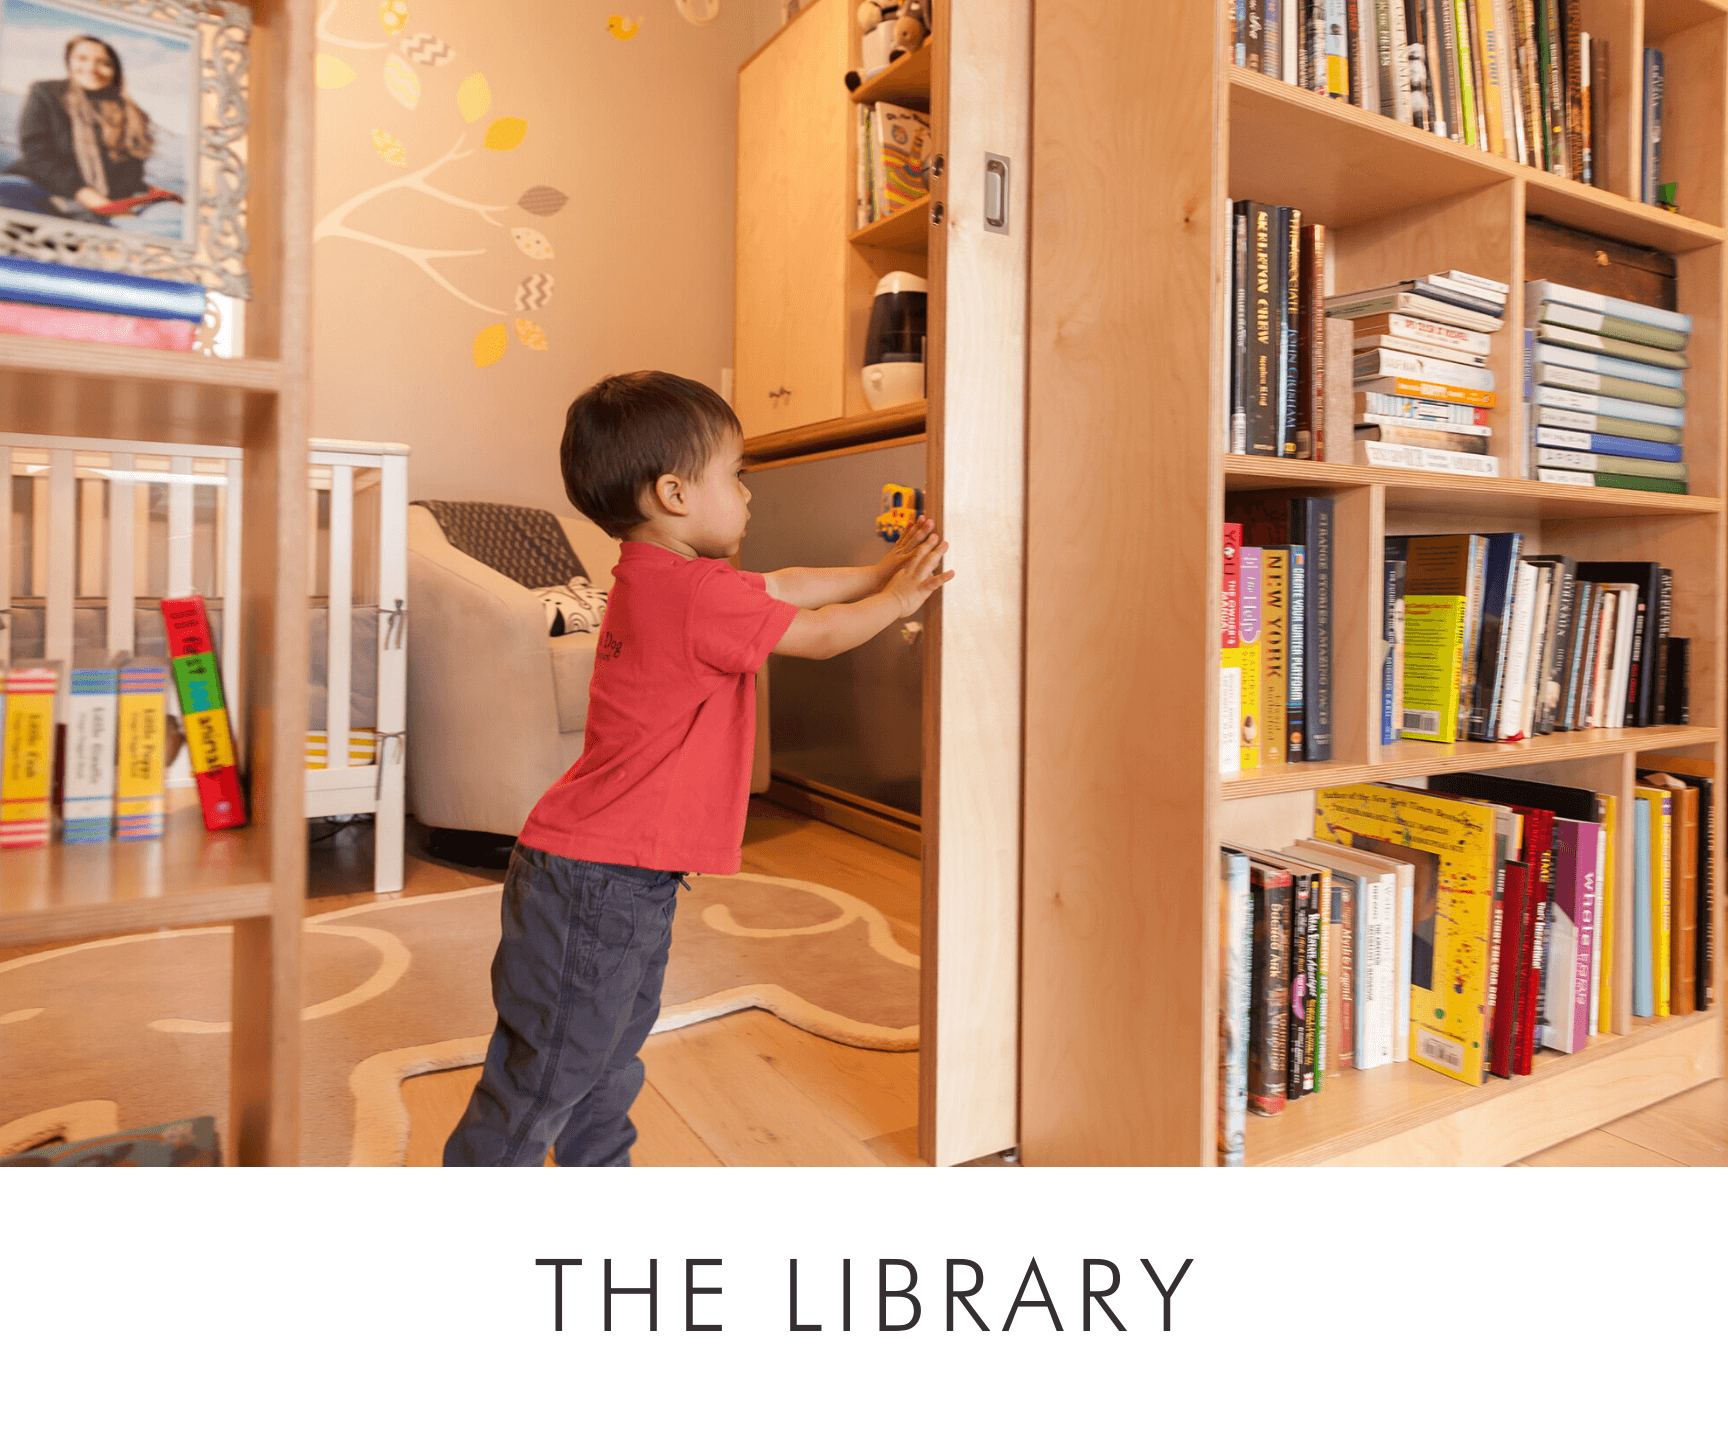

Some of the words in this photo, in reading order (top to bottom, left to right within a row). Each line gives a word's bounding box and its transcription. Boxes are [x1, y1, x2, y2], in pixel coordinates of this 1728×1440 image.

[1257, 210, 1269, 294] SKELETON
[1288, 247, 1300, 315] ASSOCIATE
[1257, 298, 1269, 344] CREW
[1287, 328, 1299, 363] JOHN
[1318, 513, 1329, 570] STRANGE
[1266, 555, 1283, 609] NEW
[1292, 568, 1304, 598] CREATE
[1242, 595, 1258, 633] Help
[1292, 599, 1304, 623] YOUR
[604, 631, 623, 659] Dog
[1265, 617, 1283, 679] YORK
[1291, 624, 1304, 656] WRITER
[1318, 628, 1329, 685] AMAZING
[1291, 657, 1303, 701] PLATFORM
